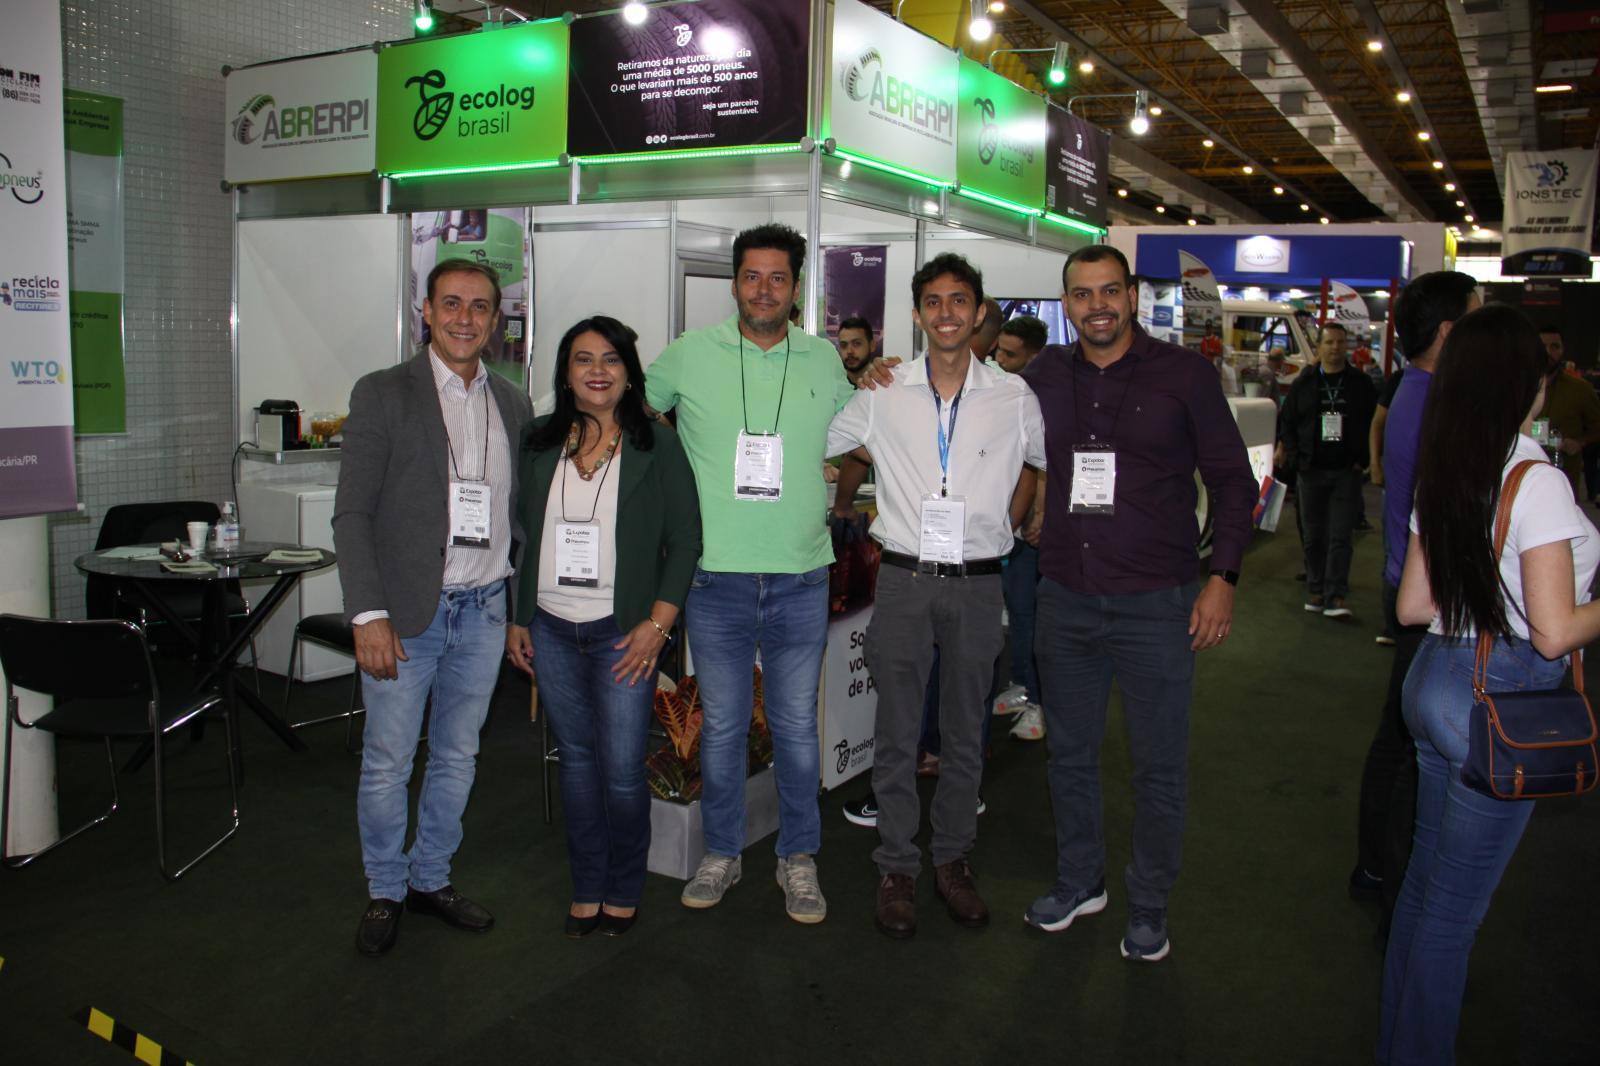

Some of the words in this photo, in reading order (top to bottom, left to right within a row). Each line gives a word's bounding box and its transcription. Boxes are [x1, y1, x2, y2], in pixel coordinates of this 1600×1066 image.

[618, 60, 661, 71] Retiramos
[662, 57, 674, 66] da
[736, 48, 752, 59] dia
[622, 72, 642, 81] uma
[644, 68, 671, 79] média
[673, 66, 685, 76] de
[687, 63, 710, 74] 5000
[712, 61, 745, 74] pneus.
[610, 83, 618, 93] O
[620, 83, 636, 94] que
[638, 78, 675, 90] levariam
[677, 75, 699, 87] mais
[700, 74, 712, 84] de
[714, 72, 733, 82] 500
[734, 71, 758, 81] anos
[459, 84, 535, 112] ecolog
[641, 90, 661, 102] para
[662, 90, 672, 98] se
[674, 85, 723, 97] decompor.
[702, 101, 716, 111] seja
[717, 101, 729, 109] um
[730, 99, 759, 109] parceiro
[717, 106, 759, 116] sustentável.
[458, 112, 510, 137] brasil
[1516, 188, 1583, 200] IONSTEC
[12, 275, 60, 289] recicla
[13, 288, 47, 299] mais
[11, 360, 60, 378] WTO
[848, 678, 864, 698] de
[851, 737, 874, 756] ecolog
